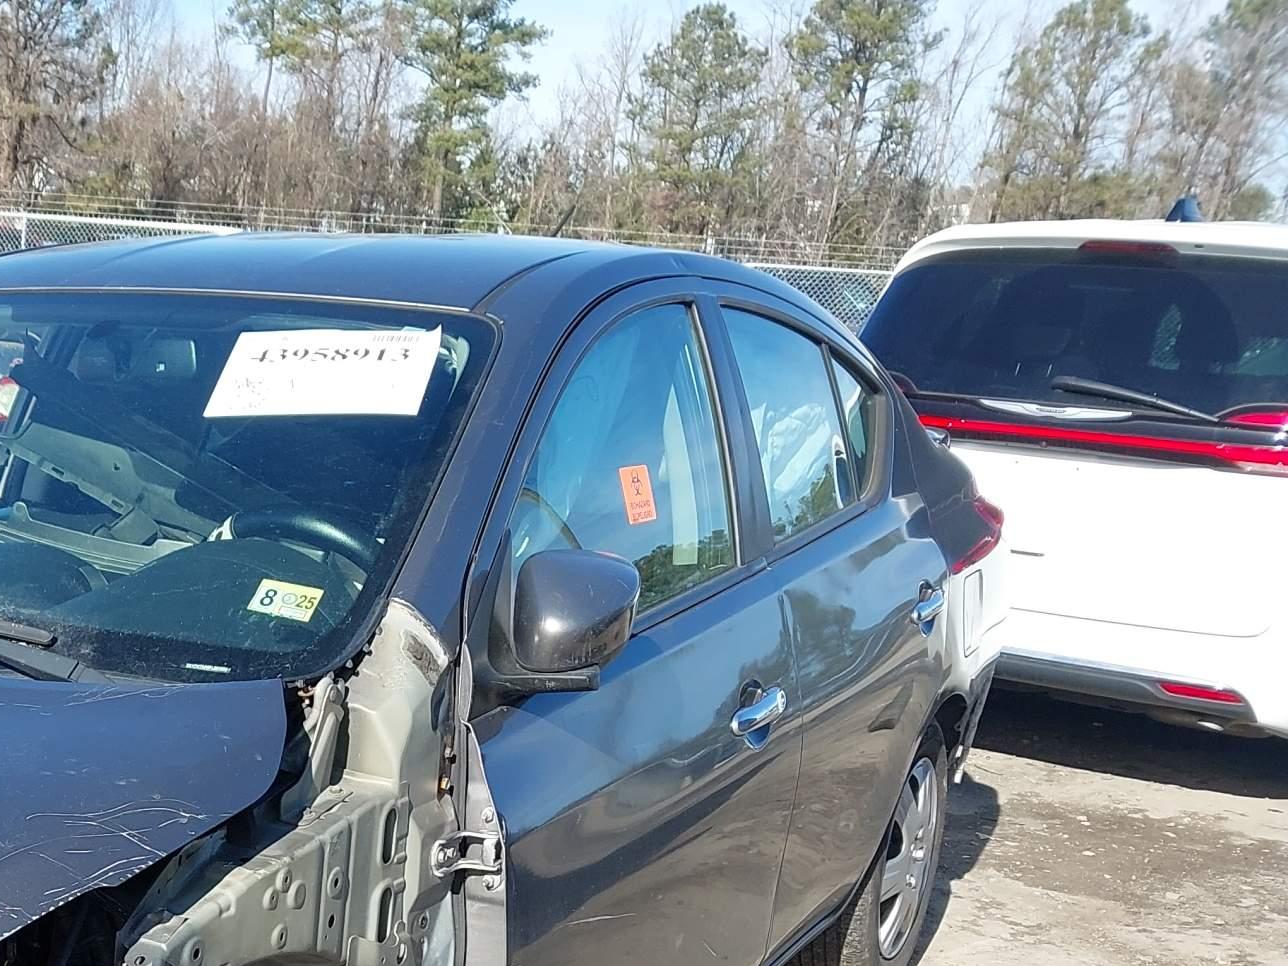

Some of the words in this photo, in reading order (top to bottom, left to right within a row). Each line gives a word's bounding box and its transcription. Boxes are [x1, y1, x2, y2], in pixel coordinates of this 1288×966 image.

[251, 346, 411, 363] 43958913
[260, 589, 278, 607] 8
[296, 595, 317, 609] 25
